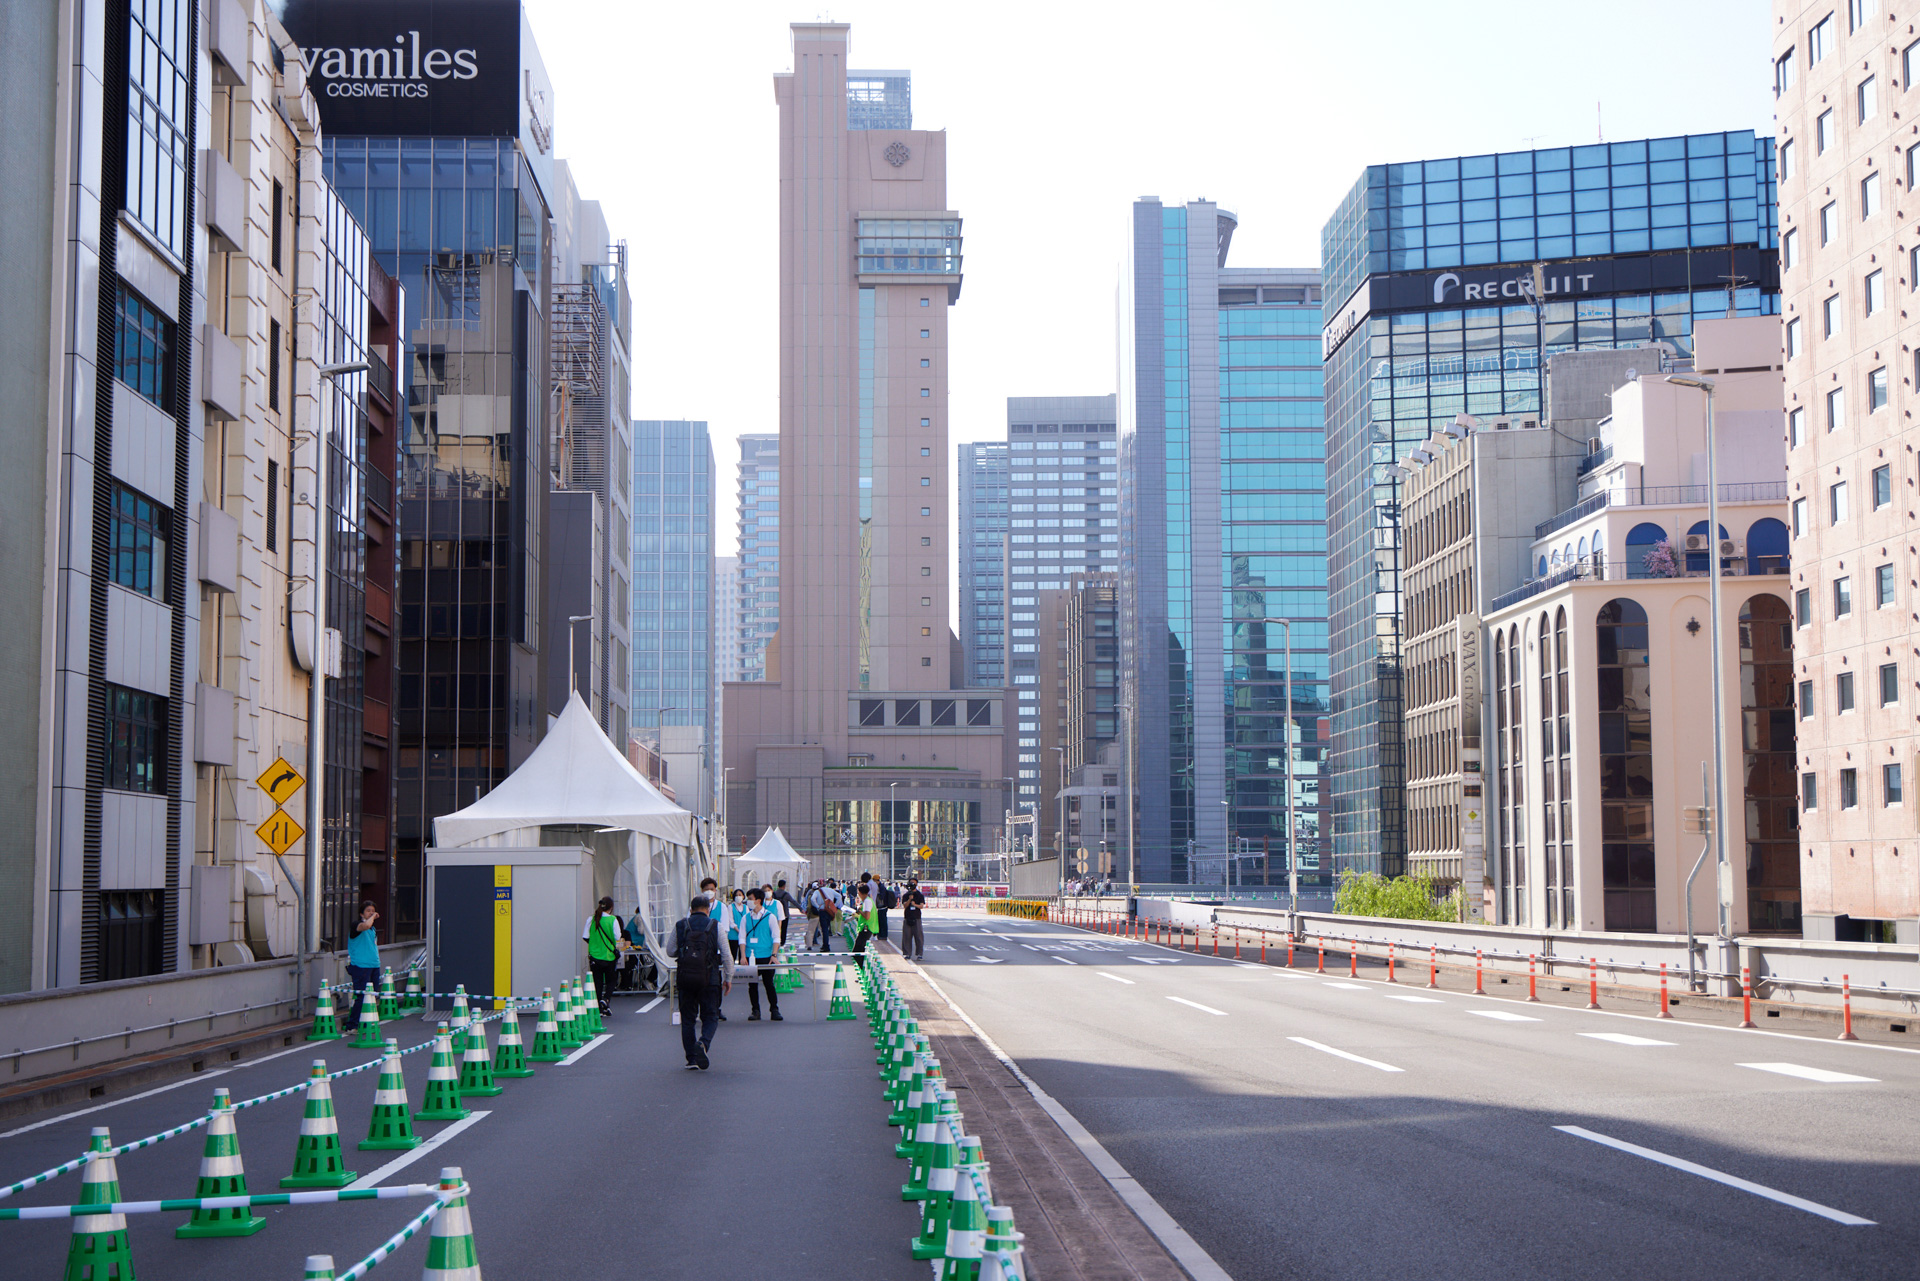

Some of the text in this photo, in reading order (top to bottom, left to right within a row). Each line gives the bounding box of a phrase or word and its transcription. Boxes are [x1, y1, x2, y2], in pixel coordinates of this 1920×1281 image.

[326, 82, 429, 98] COSMETICS
[1464, 274, 1594, 301] RECRUIT
[1463, 631, 1476, 719] SVAX GINZA
